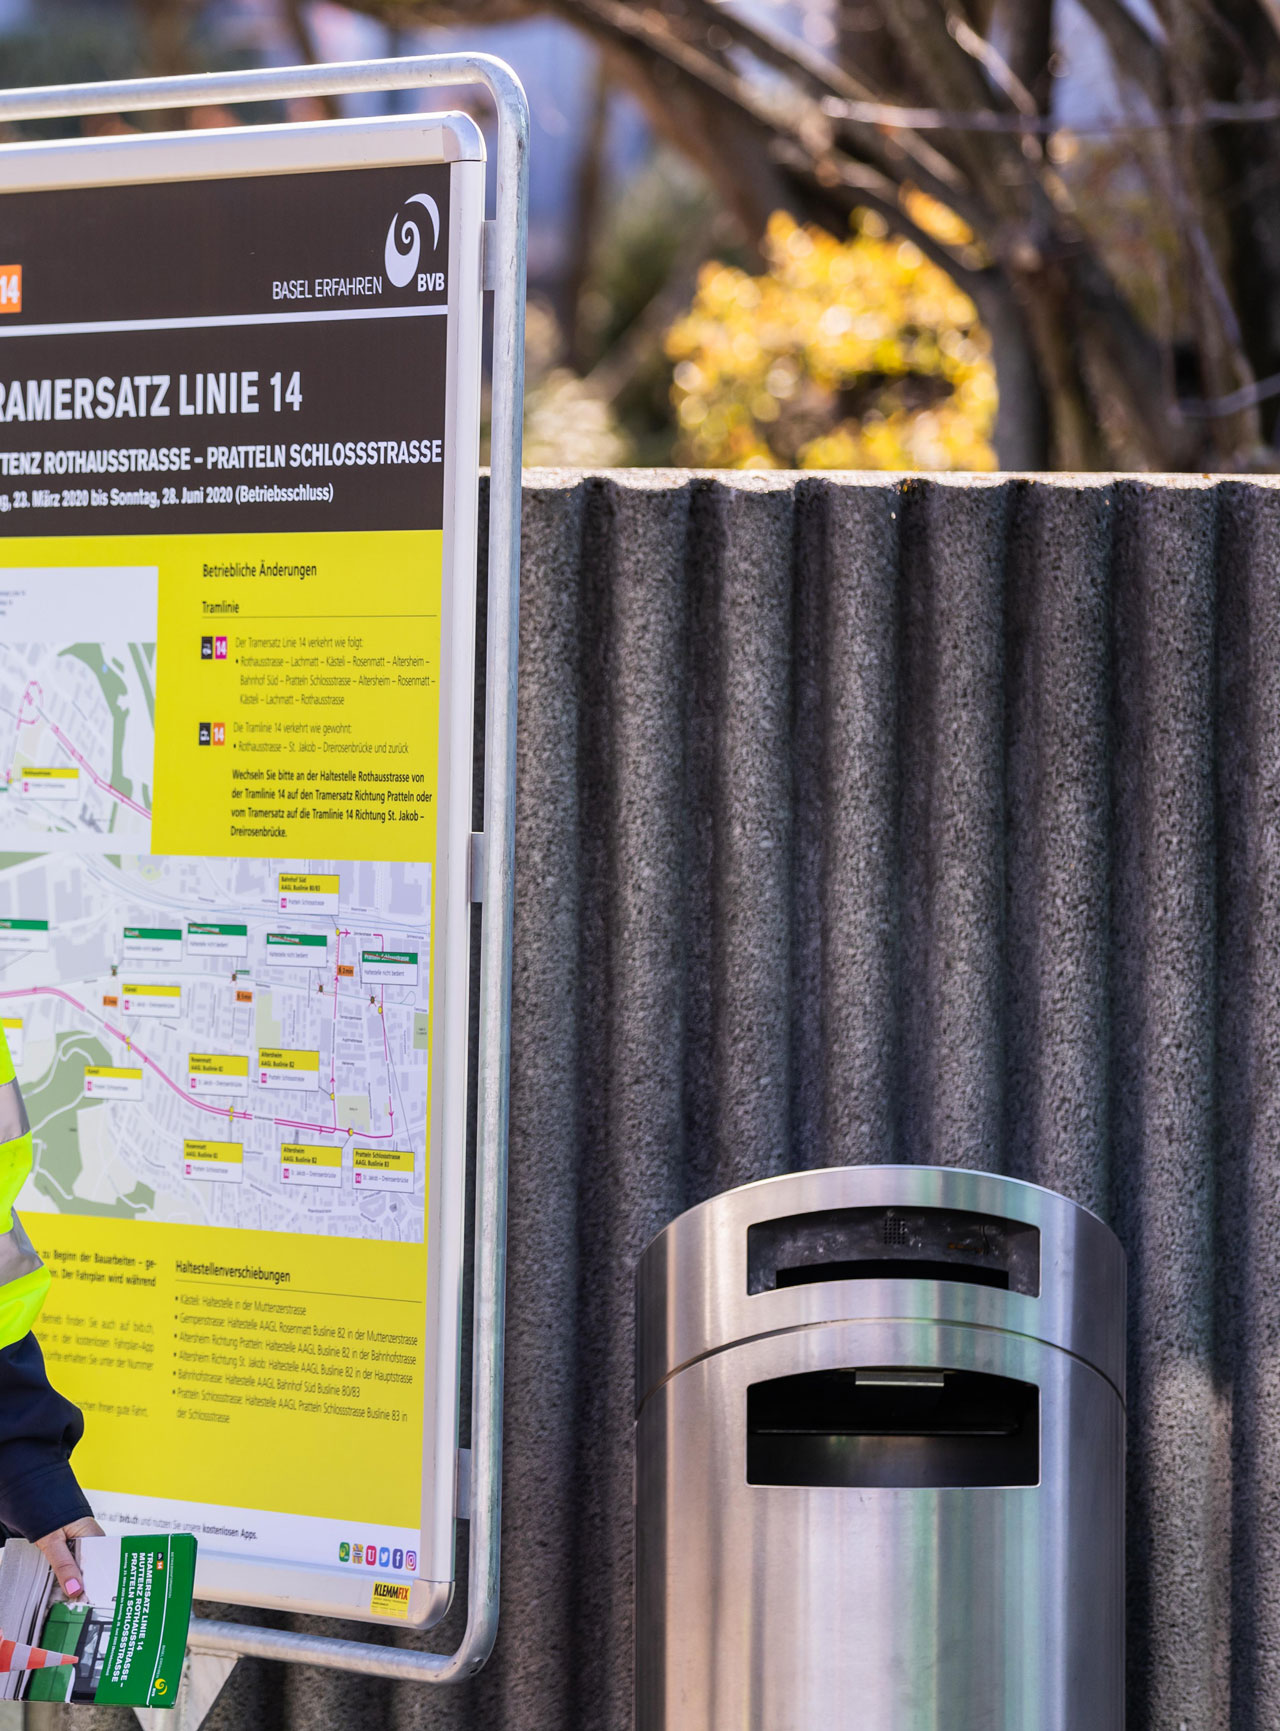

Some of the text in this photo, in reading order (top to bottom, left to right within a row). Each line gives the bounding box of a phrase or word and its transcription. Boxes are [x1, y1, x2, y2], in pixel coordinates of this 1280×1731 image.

[273, 276, 382, 299] BASEL ERFAHREN
[418, 273, 444, 292] BVB
[179, 373, 259, 415] LINIE
[271, 371, 302, 411] 14
[44, 447, 190, 474] ROTHAUSSTRASSE
[207, 445, 285, 469] PRATTELN
[290, 440, 441, 467] SCHLOSSSTRASSE
[14, 491, 28, 508] 23.
[32, 491, 60, 507] März
[63, 490, 88, 507] 2020
[91, 490, 108, 506] bis
[111, 489, 160, 509] Sonntag,
[163, 488, 178, 504] 28.
[182, 488, 203, 504] Juni
[207, 487, 233, 503] 2020
[235, 485, 333, 506] (Betriebsschluss)
[203, 561, 317, 579] Betriebliche Änderungen
[203, 601, 239, 613] Tramlinie
[216, 641, 227, 655] 14
[236, 637, 363, 649] Der Tramersatz Linie 14 verkehrt wie folgt:
[241, 657, 424, 667] Rothausstrasse Lachmatt Kästeli Rosenmatt Altersheim
[240, 676, 429, 686] Bahnhof Süd Pratteln Schlossstrasse Altersheim Rosenmatt
[240, 694, 344, 704] Kästeli Lachmatt Rothausstrasse
[213, 727, 224, 742] 14
[234, 722, 351, 735] Die Tramlinie 14 verkehrt wie gewohnt:
[239, 742, 281, 752] Rothausstrasse
[299, 742, 316, 752] Jakob
[323, 743, 372, 753] Dreirosenbrücke
[374, 743, 386, 753] und
[388, 744, 408, 753] zurück
[232, 769, 424, 782] Wechseln Sie bitte an der Haltestelle Rothausstrasse von
[232, 788, 432, 804] der Tramlinie 14 auf den Tramersatz Richtung Pratteln oder
[231, 808, 418, 823] vom Tramersatz auf die Tramlinie 14 Richtung St. Jakob
[231, 825, 287, 837] Dreirosenbrücke.
[54, 1250, 136, 1266] Beginn der Bauarbeiten
[62, 1269, 156, 1286] Der Fahrplan wird während
[176, 1261, 291, 1284] Haltestellenverschiebungen
[202, 1296, 306, 1315] Haltestelle in der Muttenzerstrasse
[259, 1321, 418, 1345] AAGL Rosenmatt Buslinie 82 in der Muttenzerstrasse
[266, 1340, 416, 1365] Haltestelle AAGL Buslinie 82 in der Bahnhofstrasse
[269, 1360, 412, 1384] Haltestelle AAGL Buslinie 82 in der Hauptstrasse
[257, 1377, 360, 1398] AAGL Bahnhof Süd Buslinie 80/83
[278, 1398, 407, 1421] AAGL Pratteln Schlossstrasse Buslinie 83 in
[202, 1524, 258, 1541] kostenlosen Apps.
[374, 1584, 409, 1600] KLEMMFIX
[136, 1552, 153, 1650] TRAMERSATZ LINIE 14
[112, 1553, 138, 1682] PRATTELN SCHLOSSSTRASSE
[122, 1553, 145, 1681] MUTTENZ ROTHAUSSTRASSE
